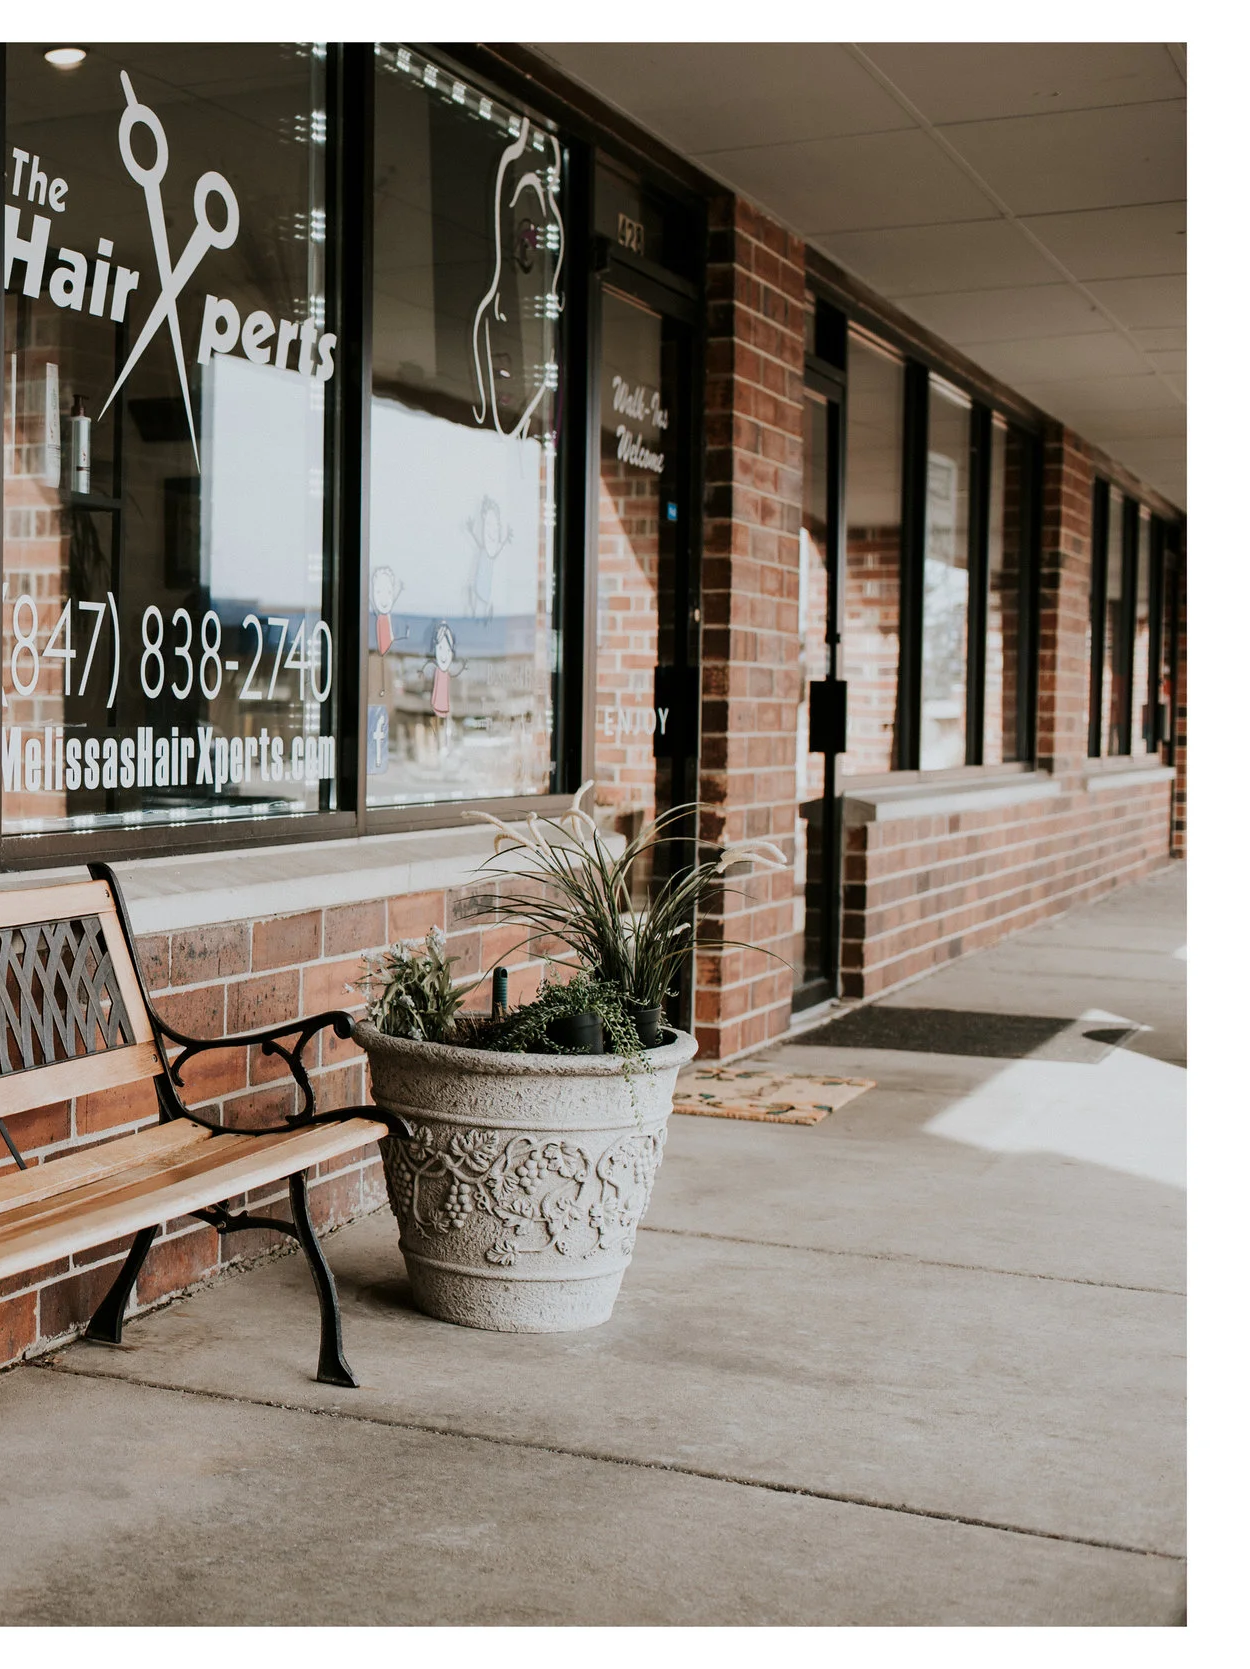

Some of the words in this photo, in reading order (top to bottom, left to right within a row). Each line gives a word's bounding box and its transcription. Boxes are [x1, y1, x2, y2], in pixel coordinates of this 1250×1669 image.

[12, 147, 69, 213] The
[3, 204, 140, 323] Hair
[616, 424, 665, 474] Welcome
[140, 604, 334, 703] 838-2740
[604, 707, 669, 736] ENJOY
[2, 726, 336, 793] MelissasHairXperts.com
